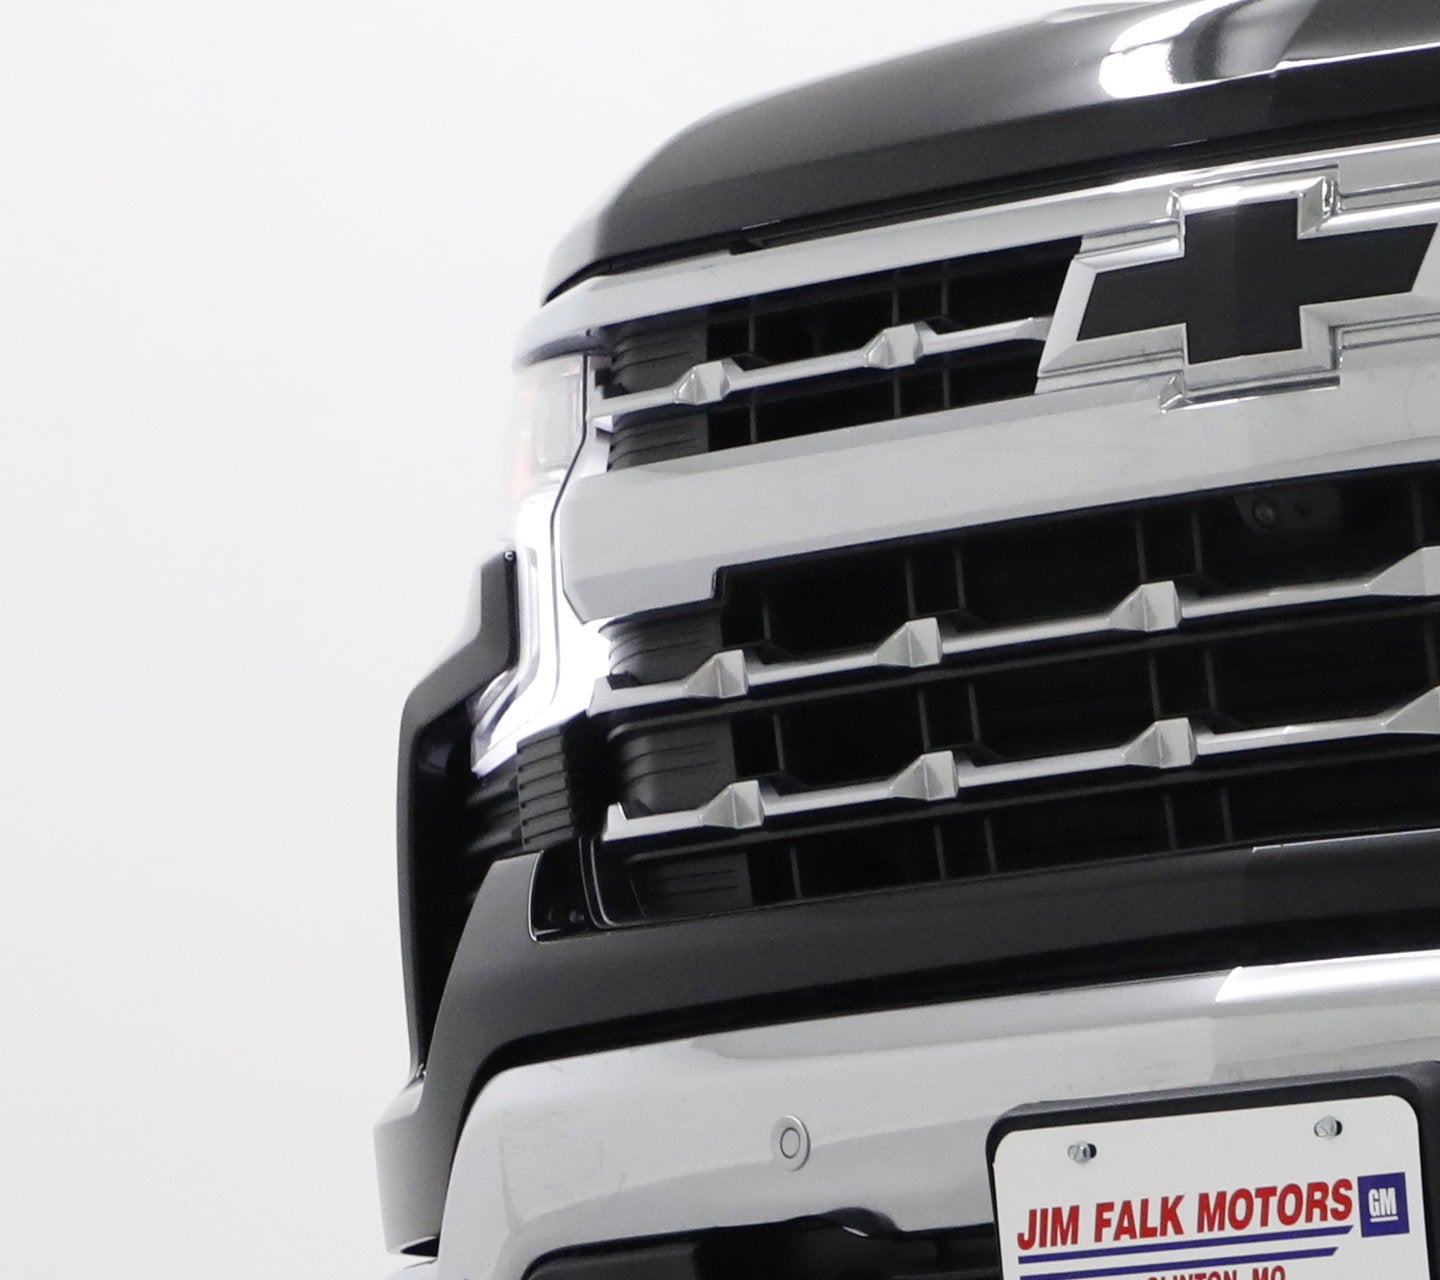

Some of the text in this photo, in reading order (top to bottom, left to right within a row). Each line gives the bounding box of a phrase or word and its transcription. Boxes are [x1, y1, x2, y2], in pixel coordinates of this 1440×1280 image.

[1017, 1178, 1354, 1250] JIM FALK MOTORS
[1368, 1187, 1398, 1217] GM
